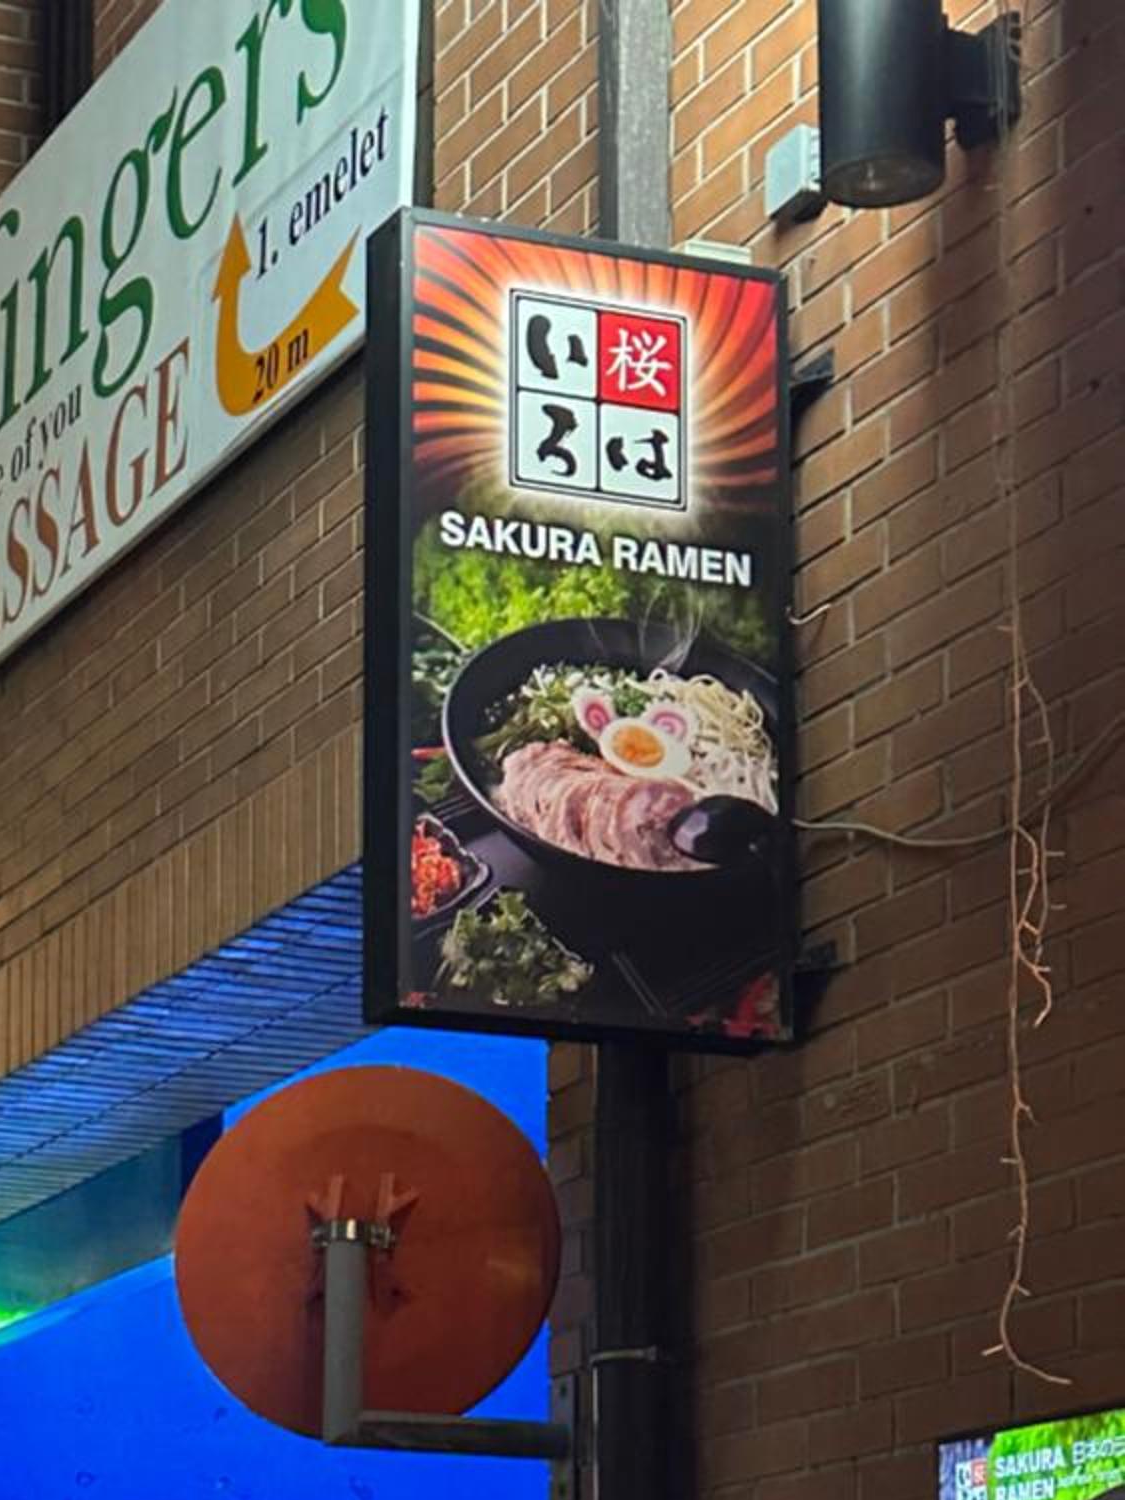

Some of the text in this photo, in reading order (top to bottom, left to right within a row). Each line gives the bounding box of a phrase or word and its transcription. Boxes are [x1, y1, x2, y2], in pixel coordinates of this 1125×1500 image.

[256, 105, 388, 280] 1. emelet
[252, 328, 310, 404] 20 m
[11, 415, 37, 482] of
[37, 384, 82, 470] you
[439, 511, 752, 587] SAKURA RAMEN
[995, 1446, 1066, 1478] SAKURA
